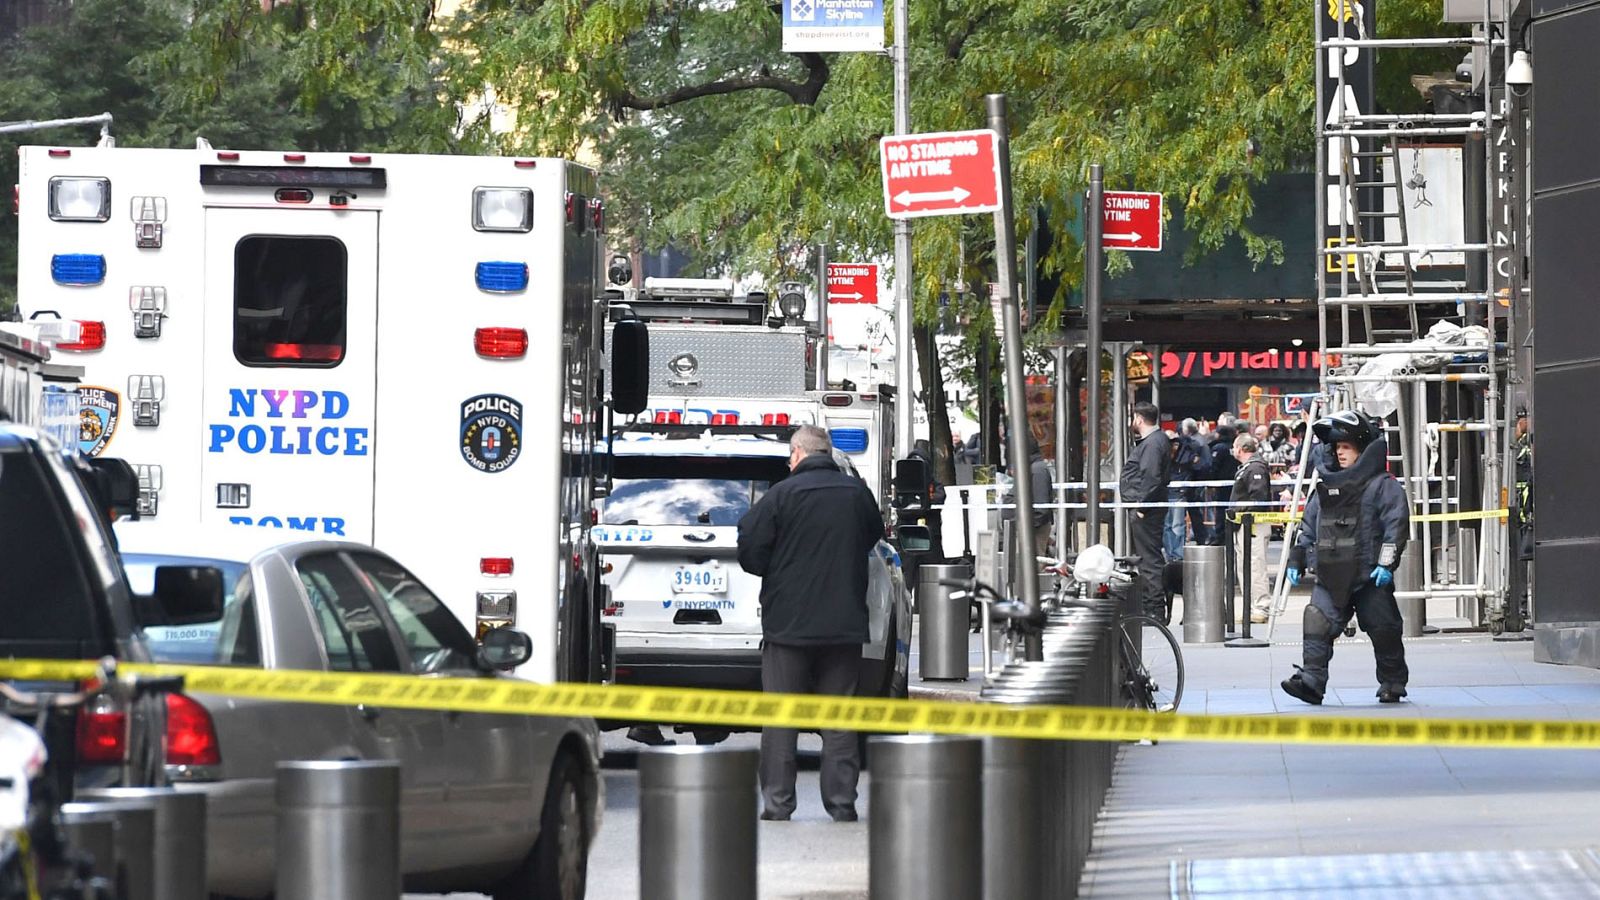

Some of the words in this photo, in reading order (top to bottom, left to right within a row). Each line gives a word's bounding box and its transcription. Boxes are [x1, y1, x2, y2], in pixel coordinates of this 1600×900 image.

[816, 0, 874, 9] Manhattan
[826, 8, 864, 22] Skyline
[887, 144, 909, 162] NO
[910, 139, 979, 160] STANDING
[890, 159, 953, 179] ANYTIME
[1105, 197, 1150, 210] STANDING
[1103, 209, 1132, 222] YTIME
[833, 267, 870, 277] STANDING
[827, 277, 855, 286] NYTIME
[80, 388, 106, 398] OLICE
[229, 389, 349, 419] NYPD
[464, 397, 520, 420] POLICE
[477, 416, 506, 428] NYPD
[91, 439, 106, 456] NEW
[104, 416, 117, 437] YORK
[209, 424, 368, 456] POLICE
[463, 446, 487, 470] BOMB
[489, 447, 518, 471] SQUAD
[675, 571, 711, 585] 3940
[675, 600, 735, 609] @NYPDMTN
